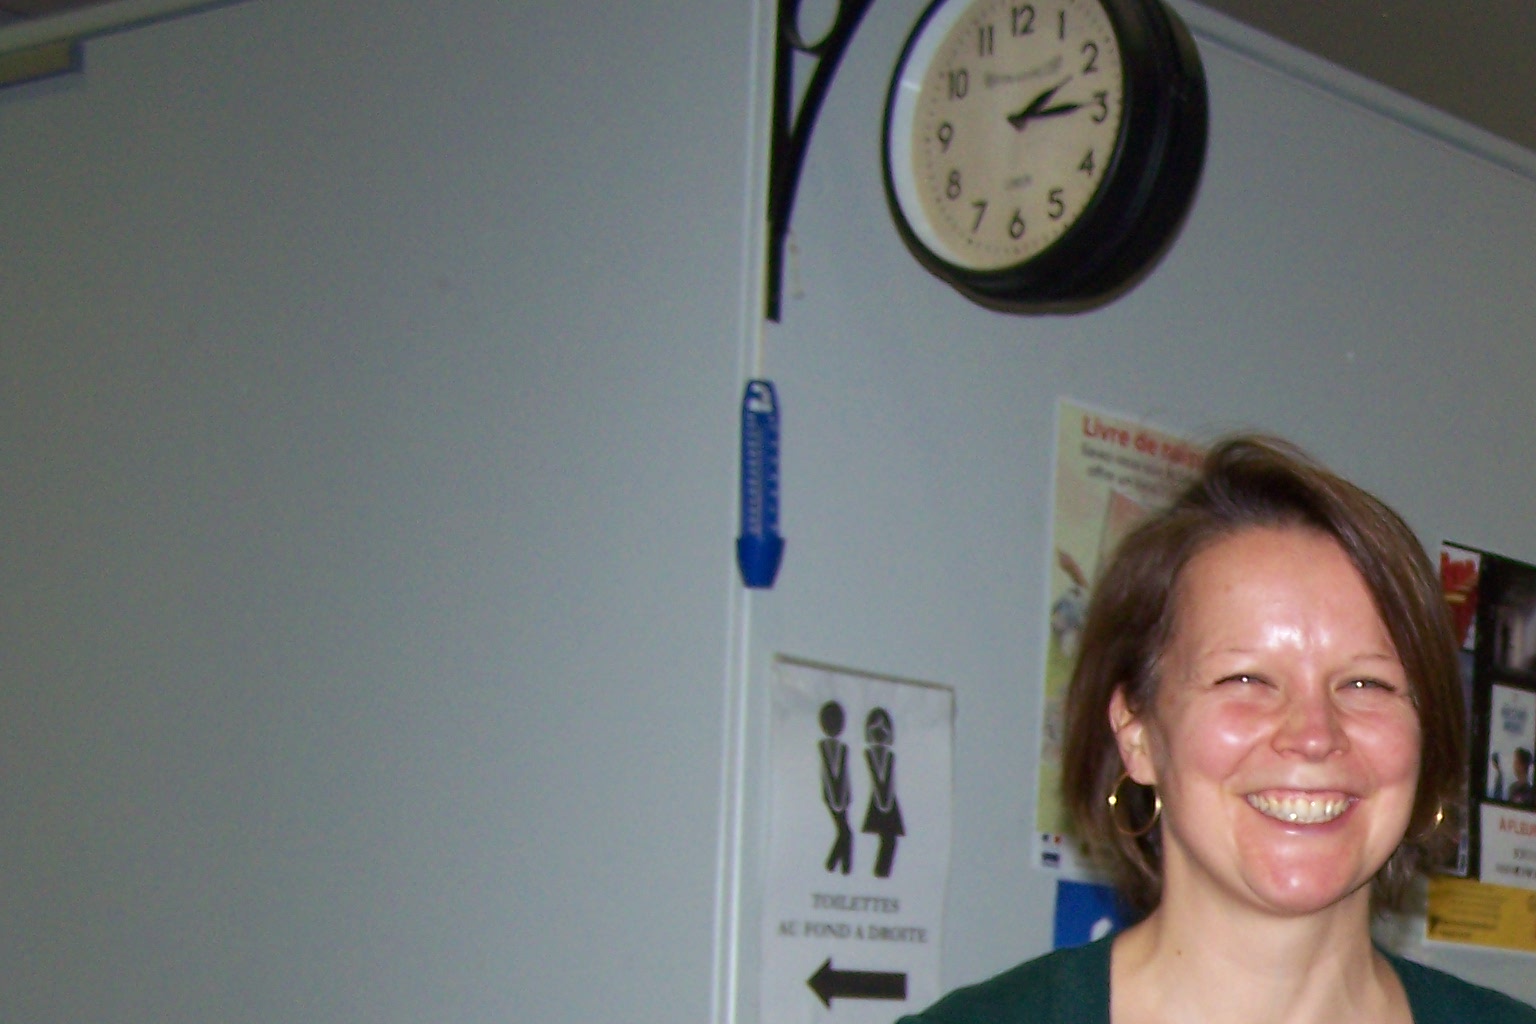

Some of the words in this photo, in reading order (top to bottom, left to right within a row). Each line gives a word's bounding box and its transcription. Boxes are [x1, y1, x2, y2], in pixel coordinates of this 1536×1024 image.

[1010, 4, 1035, 37] 12
[1057, 9, 1067, 41] 1
[978, 24, 995, 56] 11
[1083, 41, 1099, 75] 2
[951, 68, 970, 99] 10
[1091, 89, 1109, 123] 3
[937, 121, 953, 153] 9
[1079, 147, 1095, 177] 4
[946, 169, 962, 200] 8
[971, 200, 988, 235] 7
[1047, 187, 1065, 220] 5
[1008, 208, 1026, 240] 6
[810, 892, 901, 915] TOILETTES
[803, 921, 851, 940] FOND
[867, 923, 929, 944] DROITE
